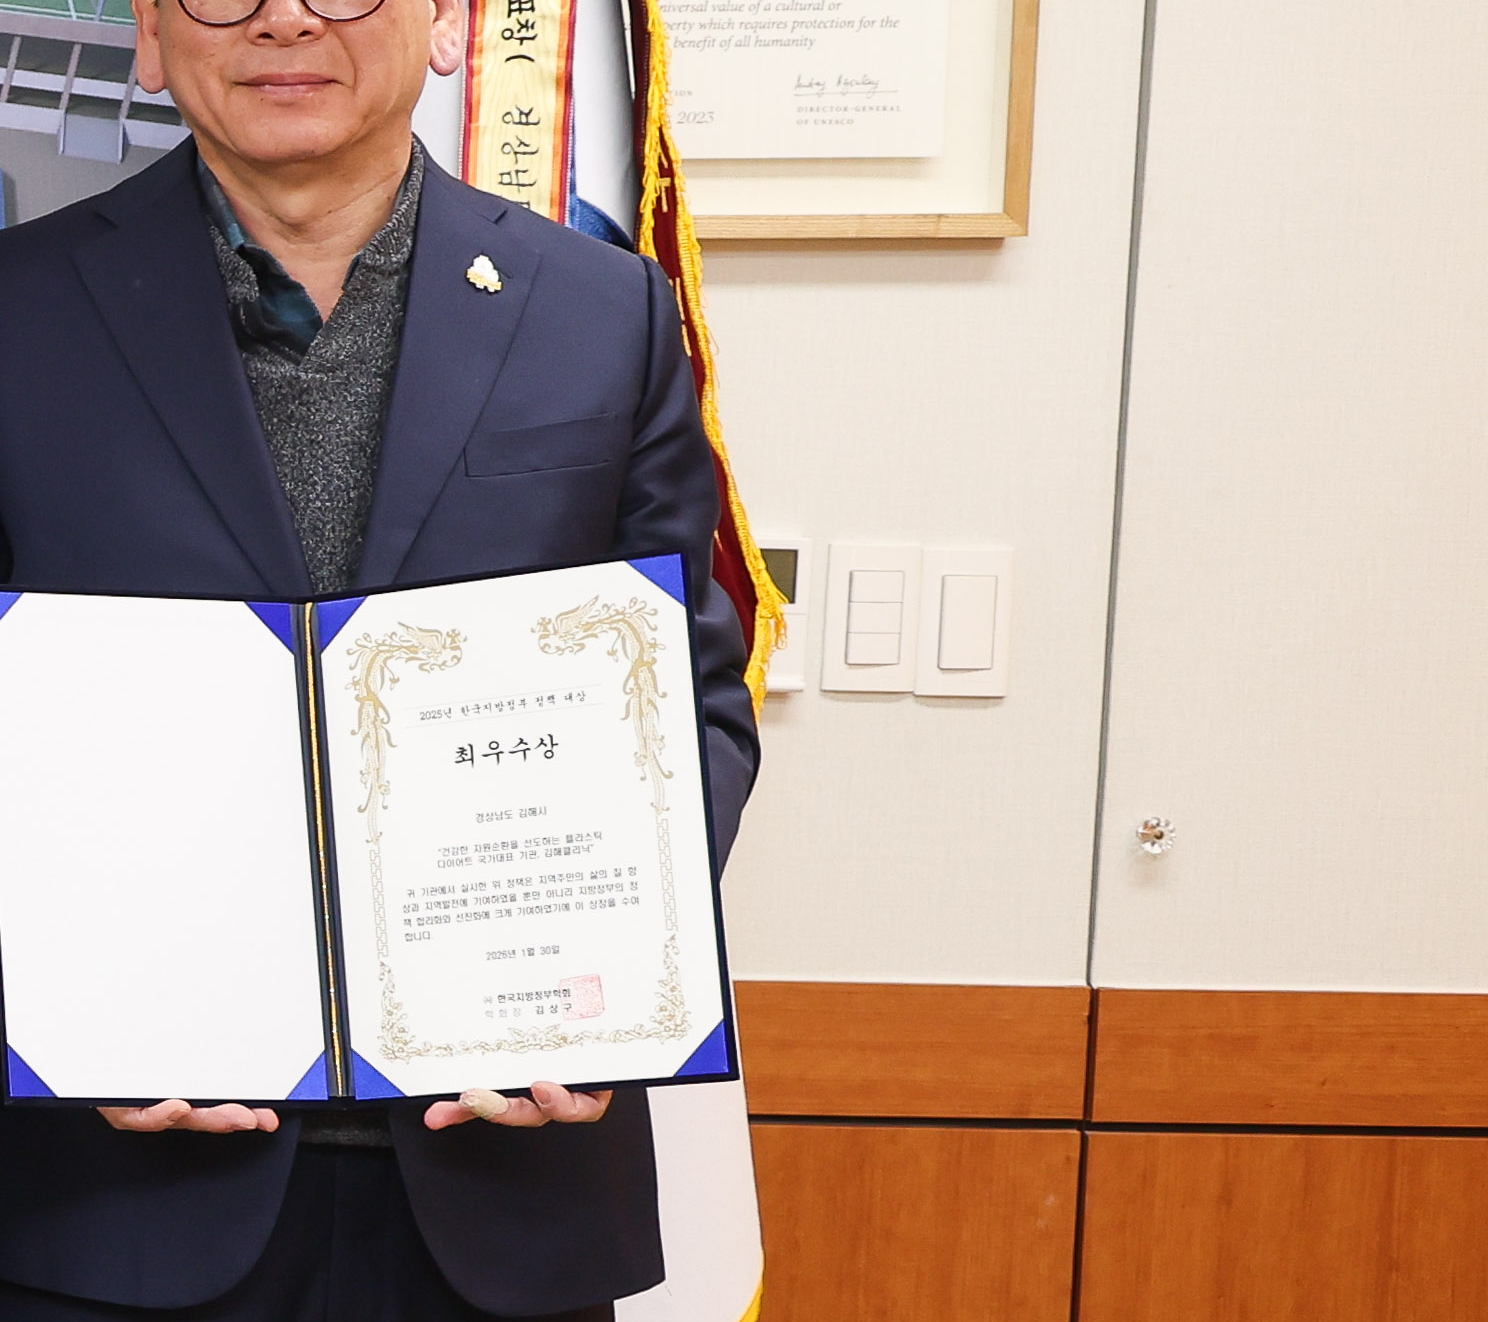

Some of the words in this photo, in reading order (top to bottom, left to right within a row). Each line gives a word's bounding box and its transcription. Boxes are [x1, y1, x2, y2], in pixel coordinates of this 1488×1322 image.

[659, 0, 708, 13] niversal
[711, 0, 745, 13] value
[748, 0, 761, 14] of
[763, 3, 772, 11] a
[775, 0, 824, 11] cultural
[828, 0, 842, 11] or
[698, 17, 735, 30] which
[739, 19, 788, 34] requires
[791, 17, 855, 31] protection
[857, 17, 875, 31] for
[879, 16, 900, 28] the
[673, 36, 716, 51] benefit
[719, 35, 734, 51] of
[736, 34, 750, 48] all
[754, 35, 816, 50] humanity
[676, 112, 714, 124] 2023
[419, 707, 452, 721] 2025년
[461, 698, 528, 716] 한국지방정부
[564, 690, 586, 703] 대상
[454, 733, 559, 768] 최우수상
[475, 810, 513, 824] 경상남도
[519, 806, 547, 819] 김해시
